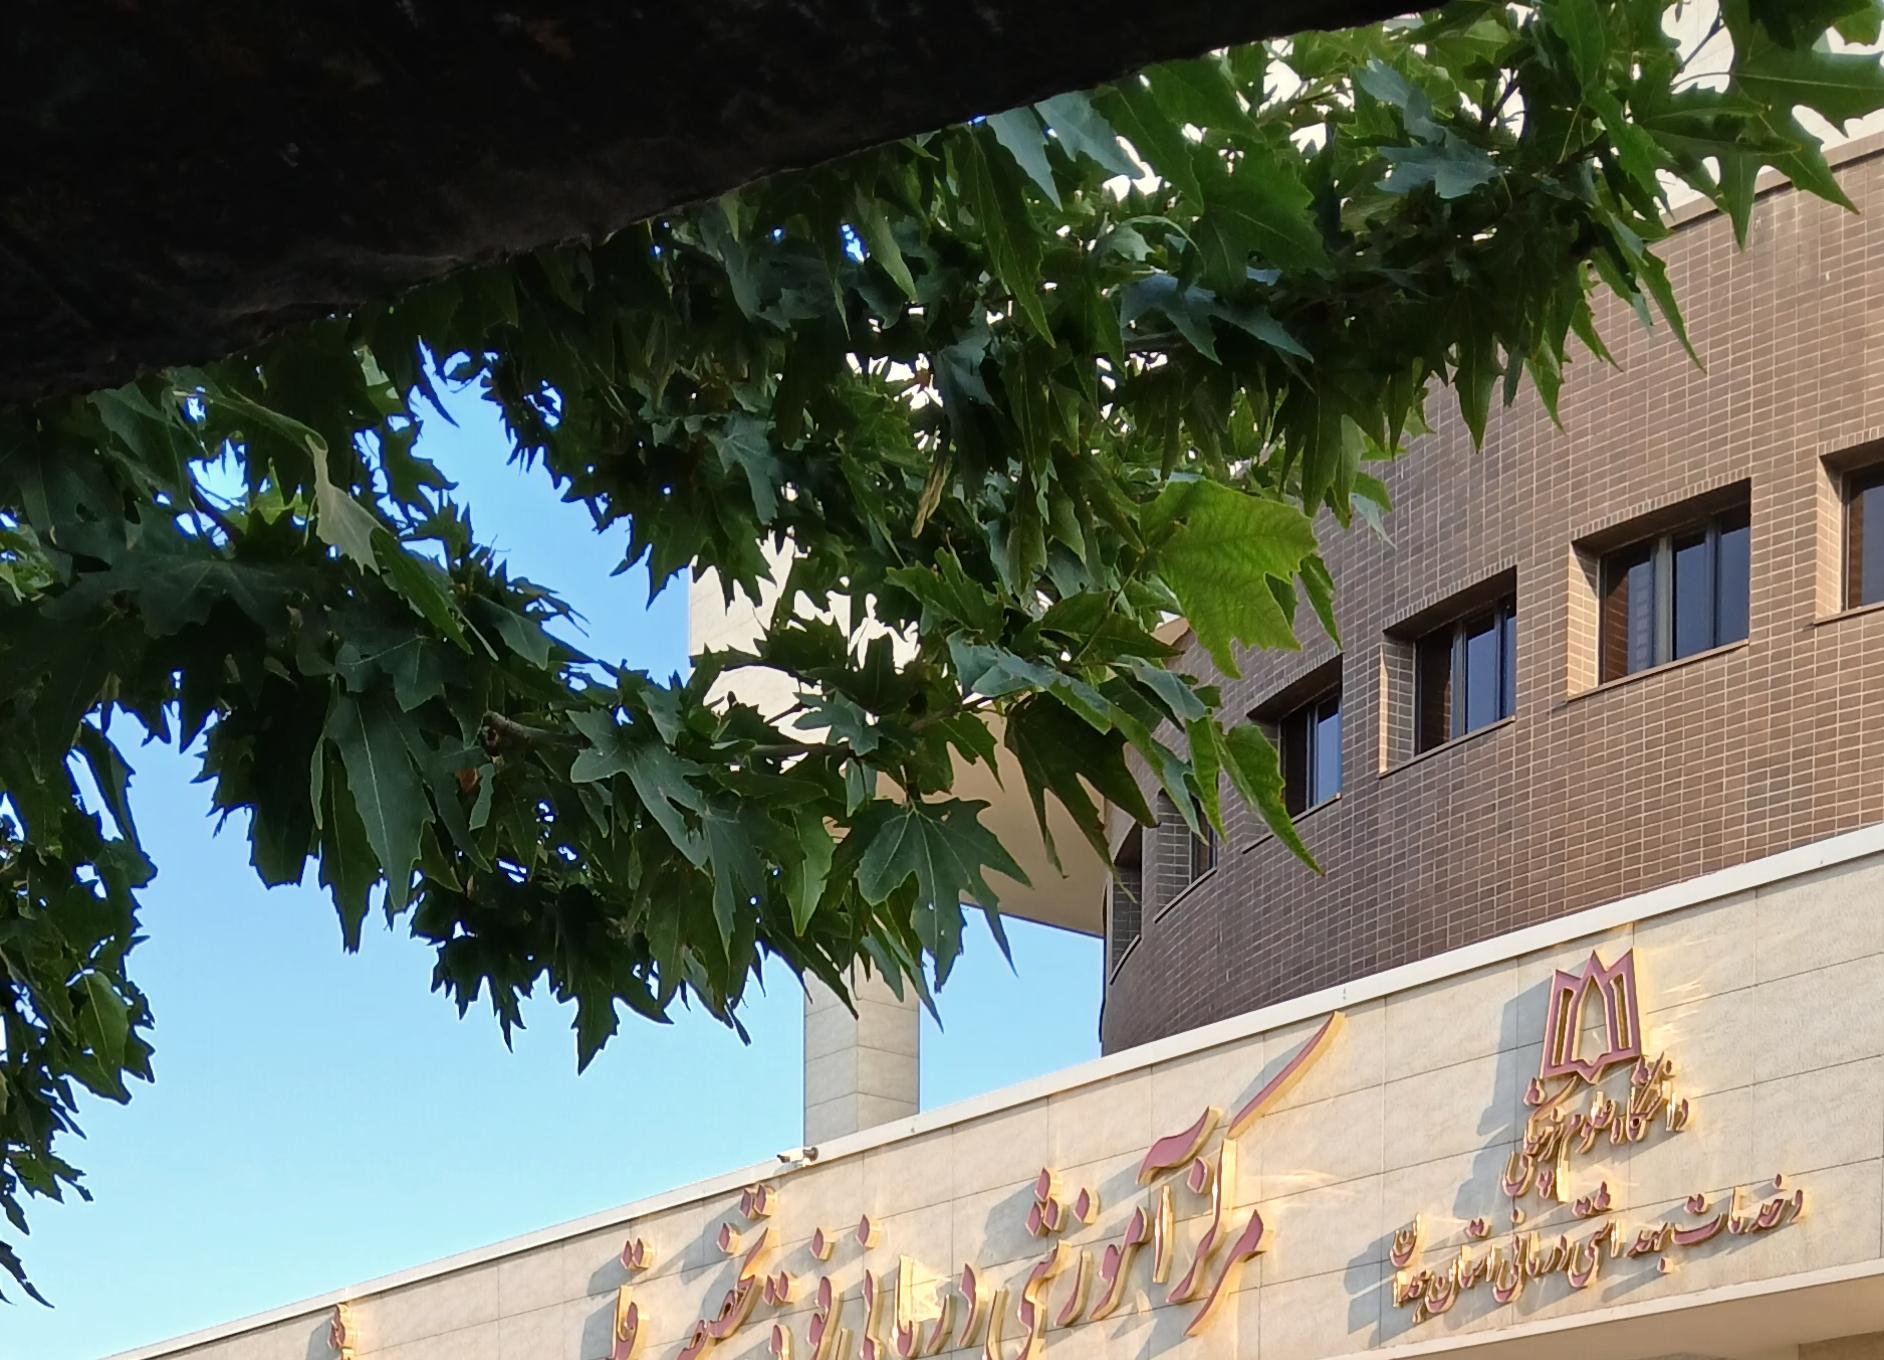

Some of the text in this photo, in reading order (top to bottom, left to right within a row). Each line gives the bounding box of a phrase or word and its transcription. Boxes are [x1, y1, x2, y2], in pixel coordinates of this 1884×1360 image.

[1609, 1051, 1691, 1145] دانشگاه
[1166, 1010, 1346, 1338] مرکز
[1671, 1172, 1787, 1246] خدمات
[1787, 1188, 1808, 1223] و
[1492, 1208, 1573, 1304] درمانی
[1567, 1180, 1676, 1289] بهداشتی
